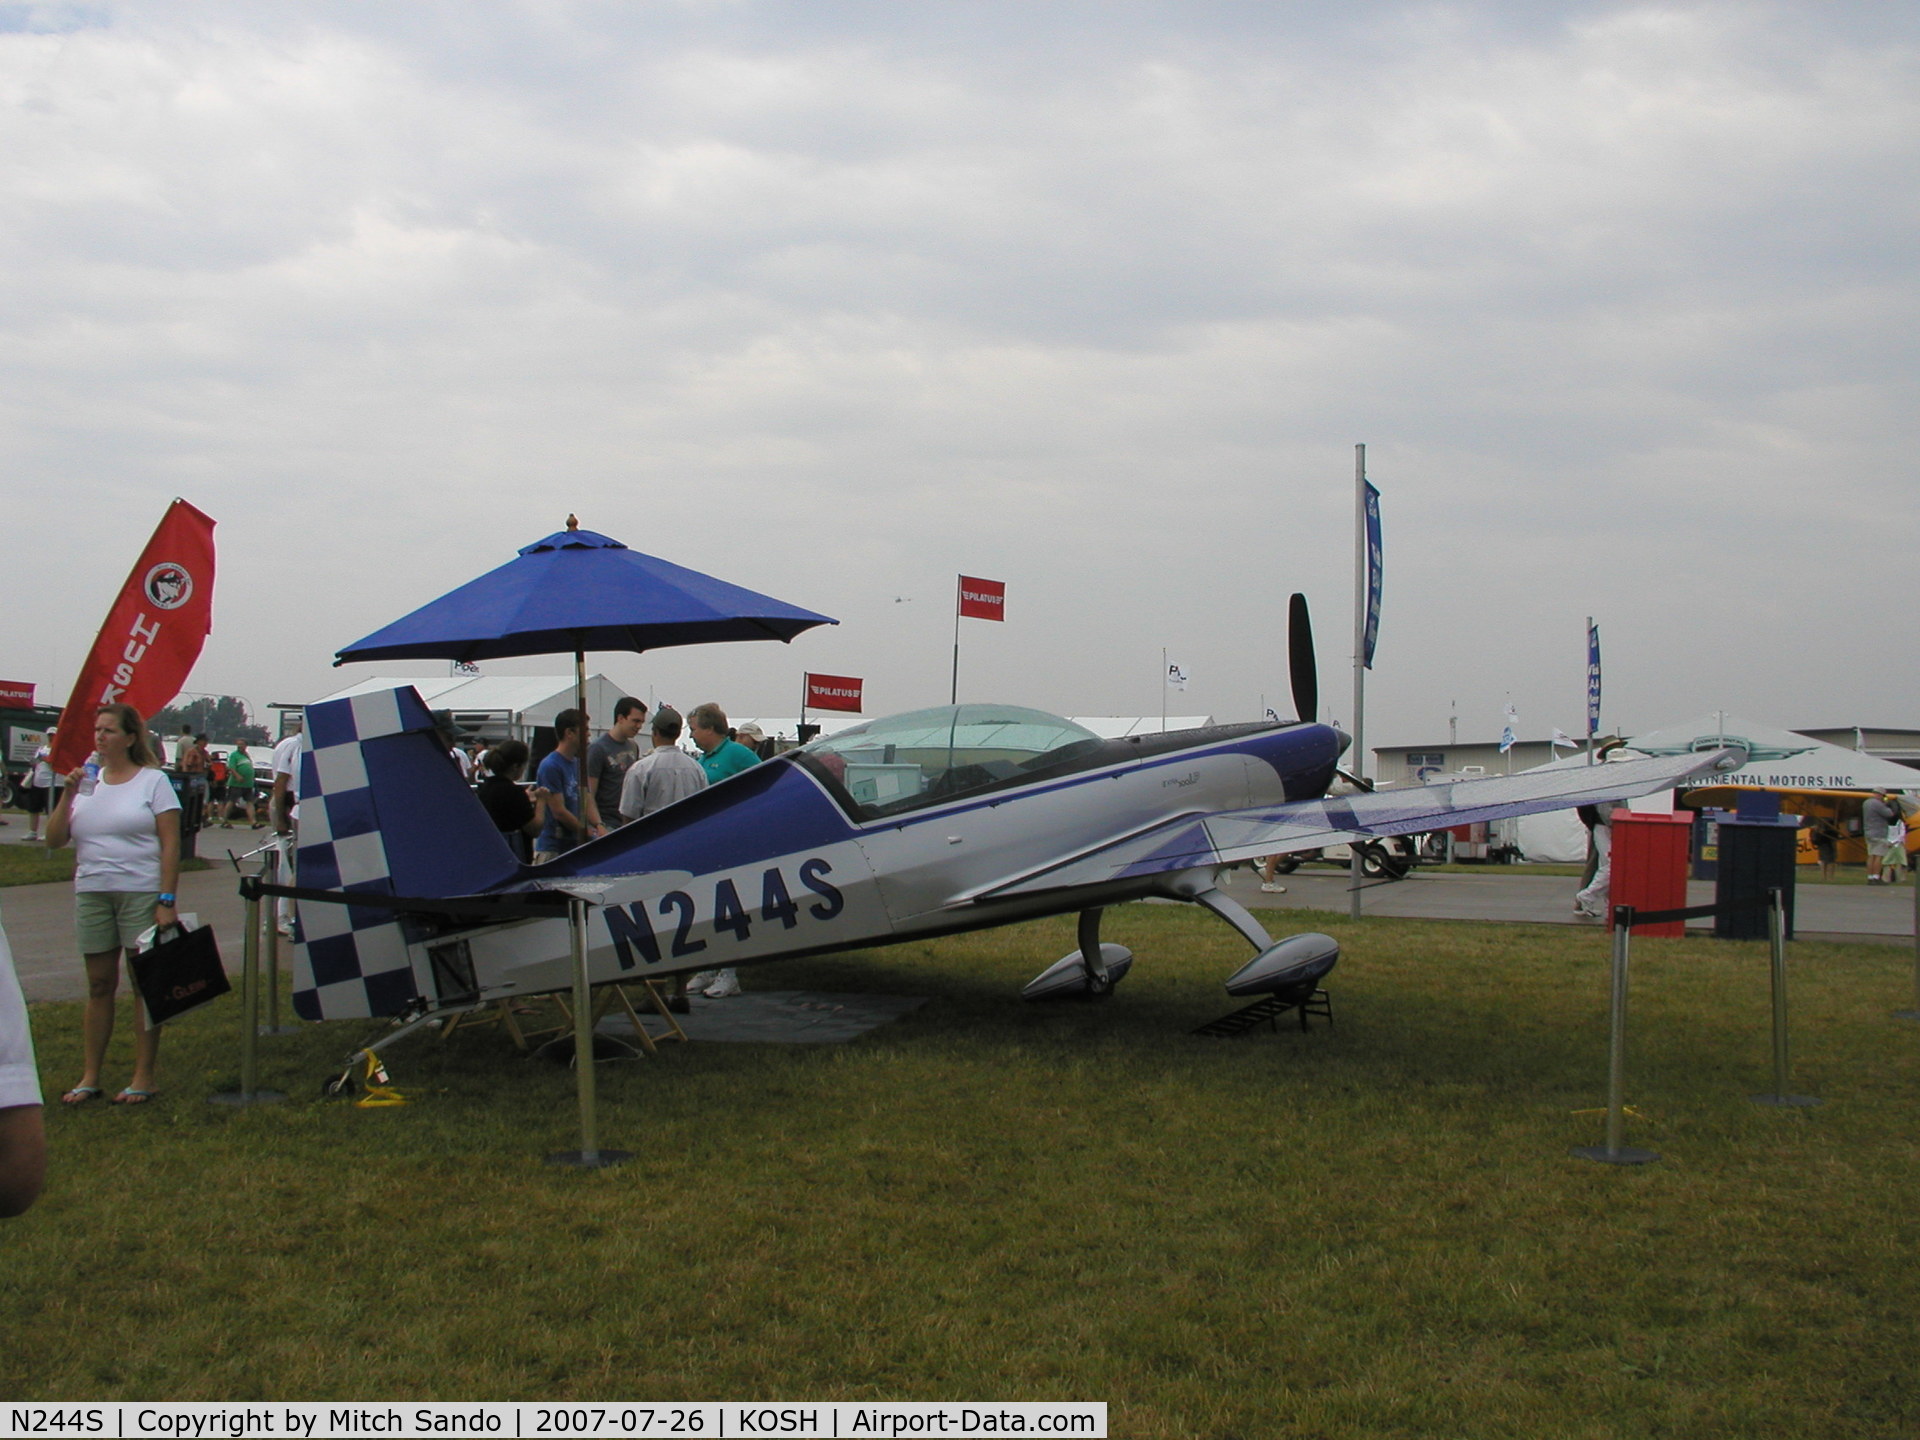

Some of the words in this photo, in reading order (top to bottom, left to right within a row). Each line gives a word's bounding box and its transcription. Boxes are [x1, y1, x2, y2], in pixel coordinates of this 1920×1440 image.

[969, 592, 1000, 604] PILATUS
[97, 612, 161, 708] HUSK
[819, 686, 854, 698] PILATUS
[603, 857, 844, 971] N244S
